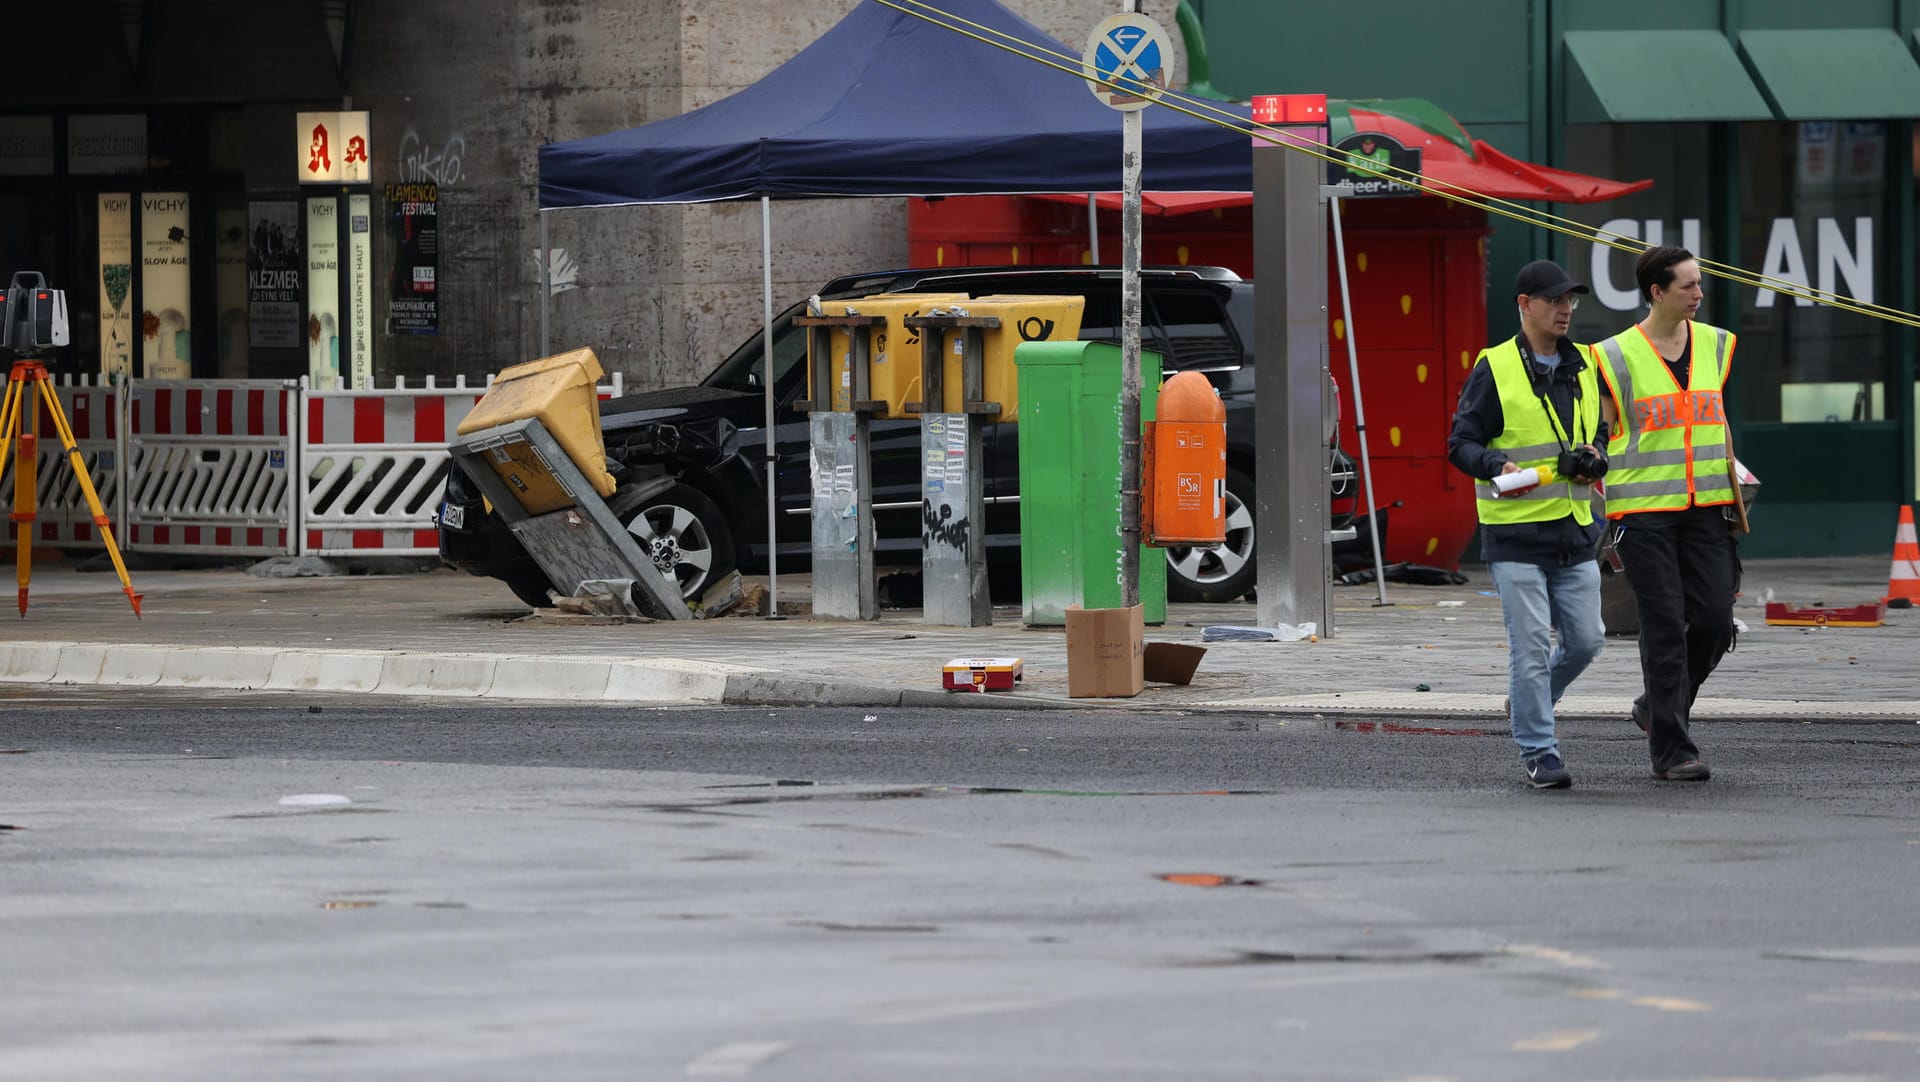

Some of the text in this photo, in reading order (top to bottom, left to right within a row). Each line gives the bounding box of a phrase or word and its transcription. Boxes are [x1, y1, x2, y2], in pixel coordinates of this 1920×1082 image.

[385, 184, 437, 203] FLAMENCO
[104, 199, 128, 212] VICHY
[143, 199, 187, 212] VICHY
[311, 204, 335, 216] VICHY
[402, 202, 437, 216] FESTIVAL
[144, 256, 168, 266] SLOW
[310, 261, 326, 271] SLOW
[249, 270, 299, 290] KLEZMER
